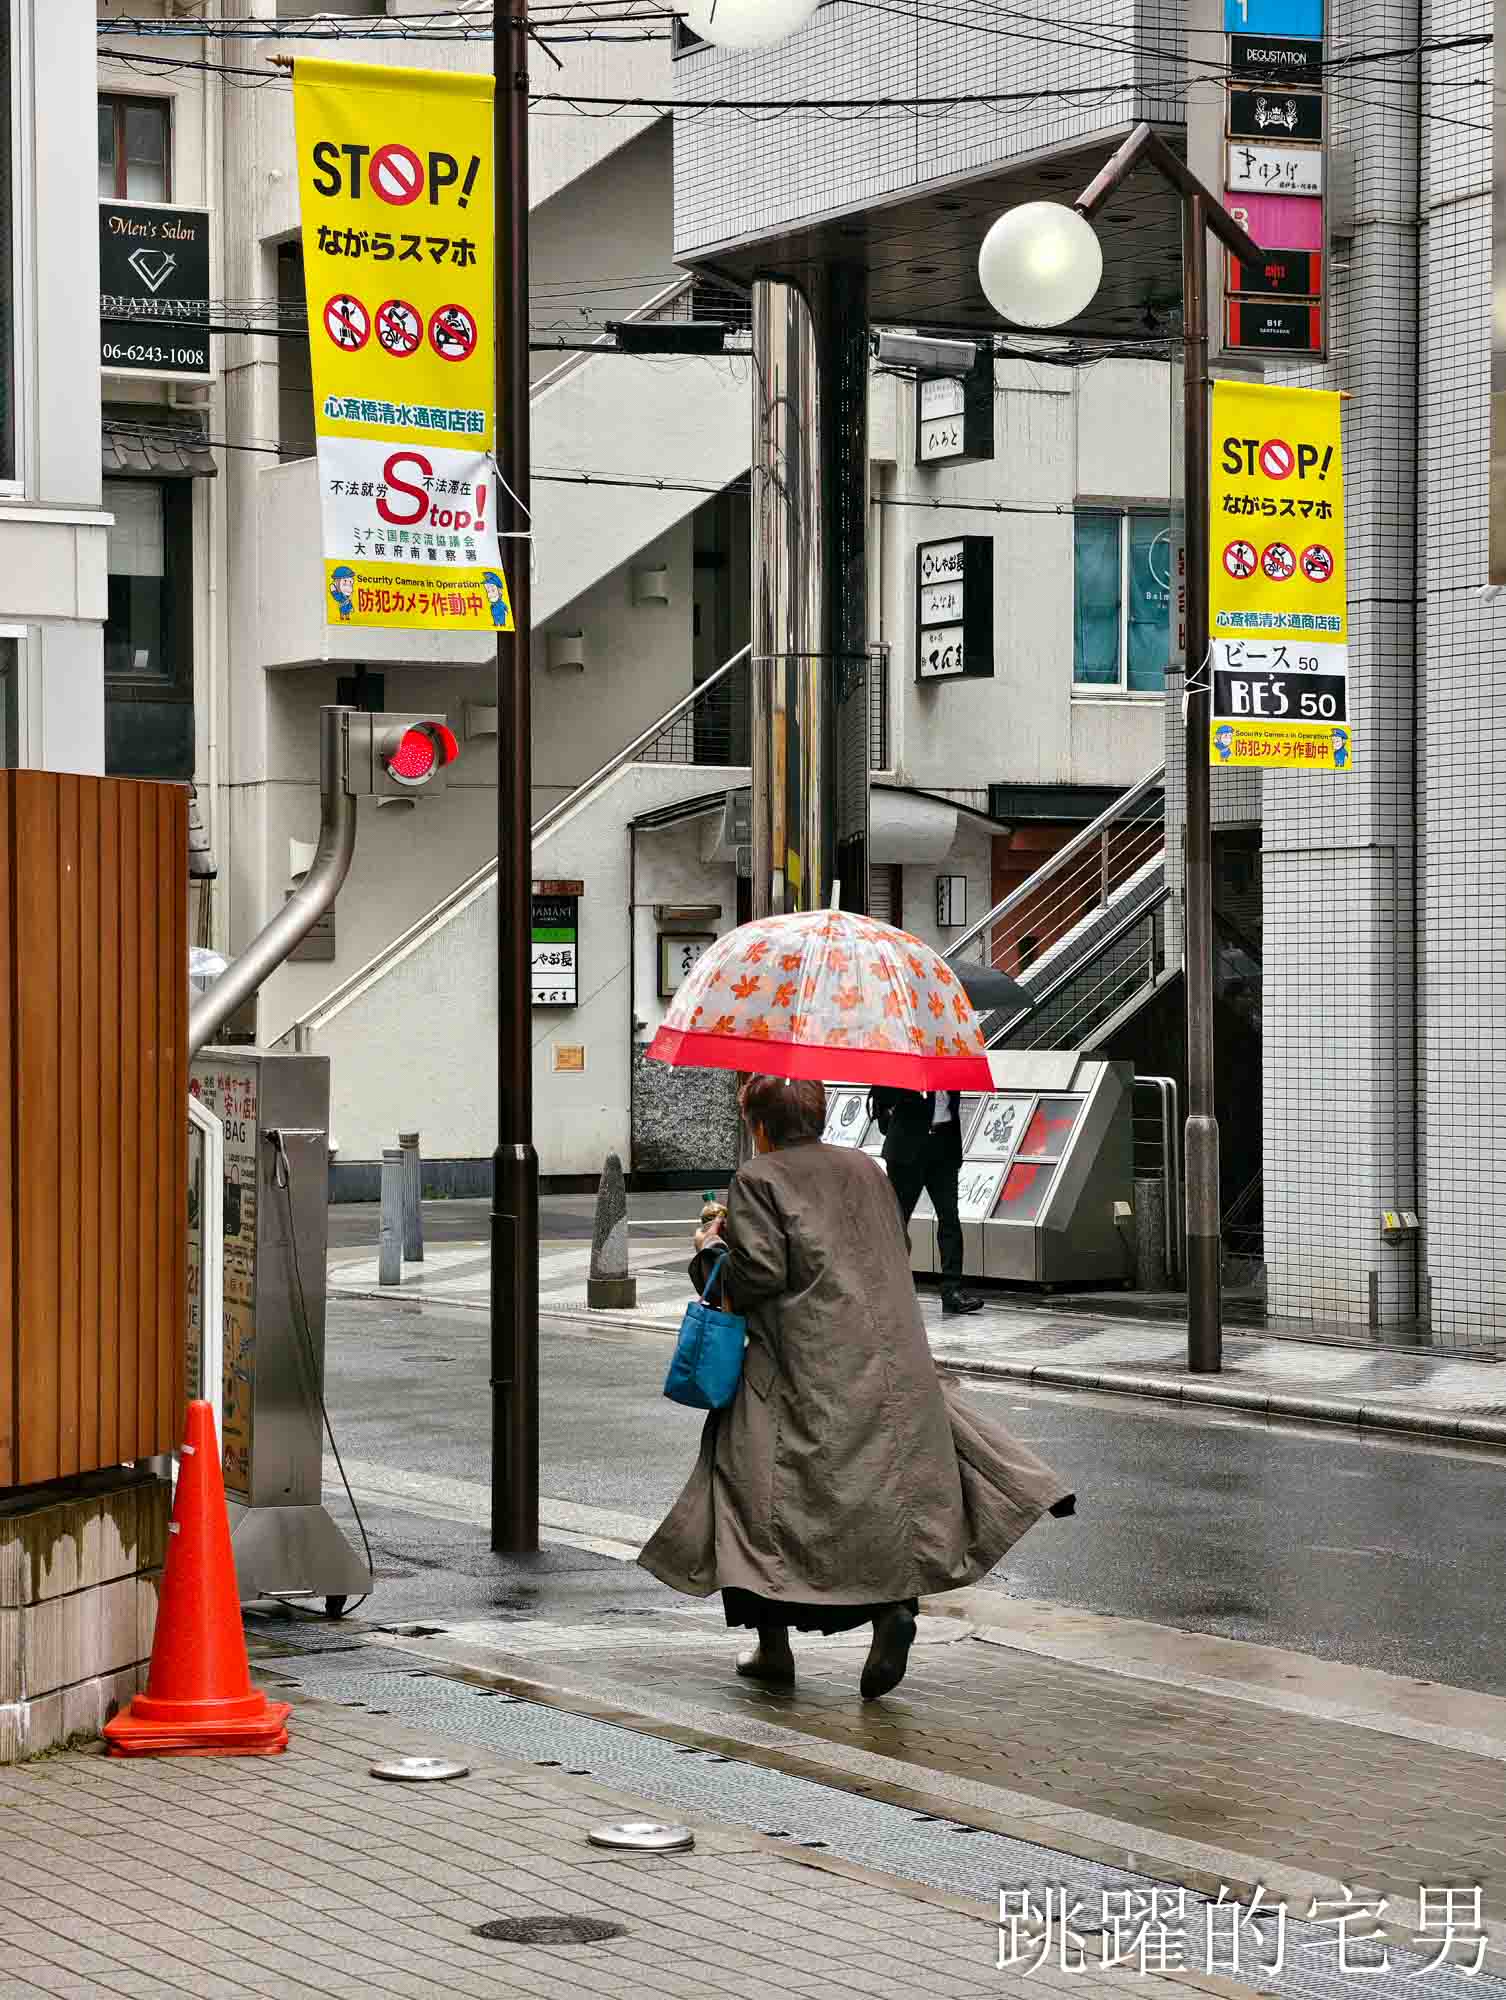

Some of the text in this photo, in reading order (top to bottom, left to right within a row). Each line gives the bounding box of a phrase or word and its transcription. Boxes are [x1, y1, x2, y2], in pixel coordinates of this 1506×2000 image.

[1246, 49, 1307, 65] DEGUSTATION
[312, 141, 481, 208] STOP!
[108, 216, 196, 241] Men's Salon
[316, 225, 477, 267] ながらスマホ
[101, 295, 207, 318] DIAMANT
[102, 343, 204, 364] 06-6243-1008
[324, 396, 485, 433] 心斎橋清水通商店街
[1222, 437, 1334, 481] STOP!
[330, 480, 388, 498] 不法就労
[421, 476, 473, 496] 不法滞在
[1223, 494, 1333, 520] ながらスマホ
[353, 527, 476, 547] ミナミ国際交流協議会
[357, 574, 393, 585] Security
[395, 576, 425, 587] Camera
[436, 580, 480, 590] Operation
[358, 587, 483, 617] 防犯カメラ作動中
[1216, 611, 1341, 631] 心斎橋清水通商店街
[1224, 642, 1319, 672] ビース 50
[1300, 692, 1337, 718] 50
[1235, 739, 1329, 760] 防犯カメラ作動中
